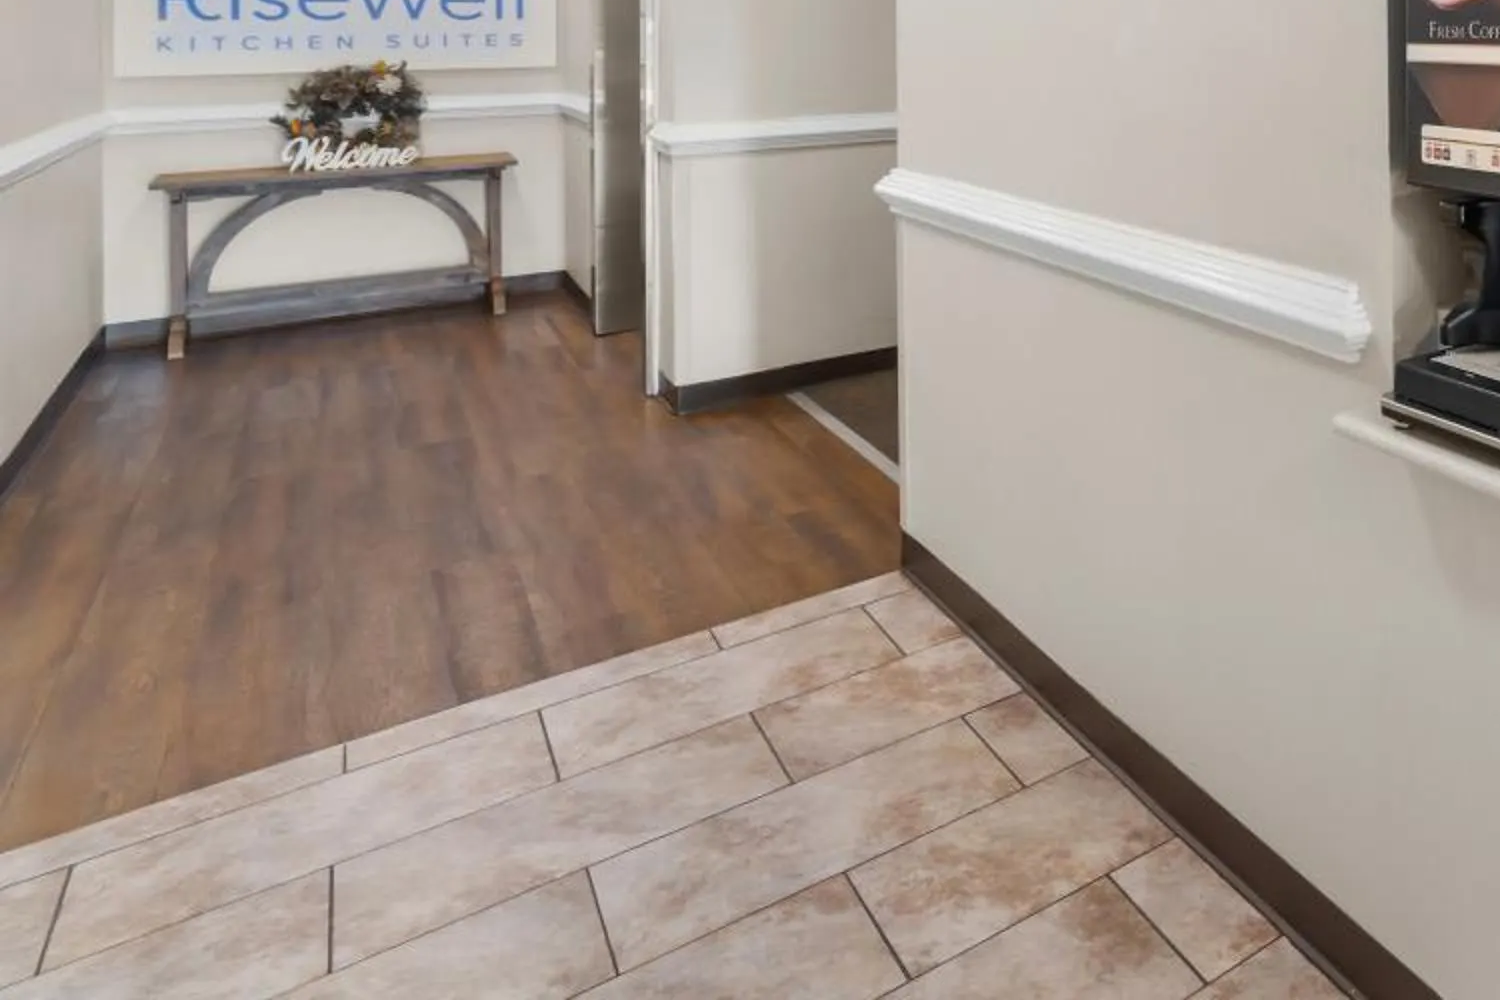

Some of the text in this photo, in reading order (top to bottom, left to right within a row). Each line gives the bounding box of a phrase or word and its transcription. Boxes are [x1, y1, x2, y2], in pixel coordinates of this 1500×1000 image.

[157, 32, 524, 52] KITCHEN SUITES
[281, 136, 417, 173] Welcome
